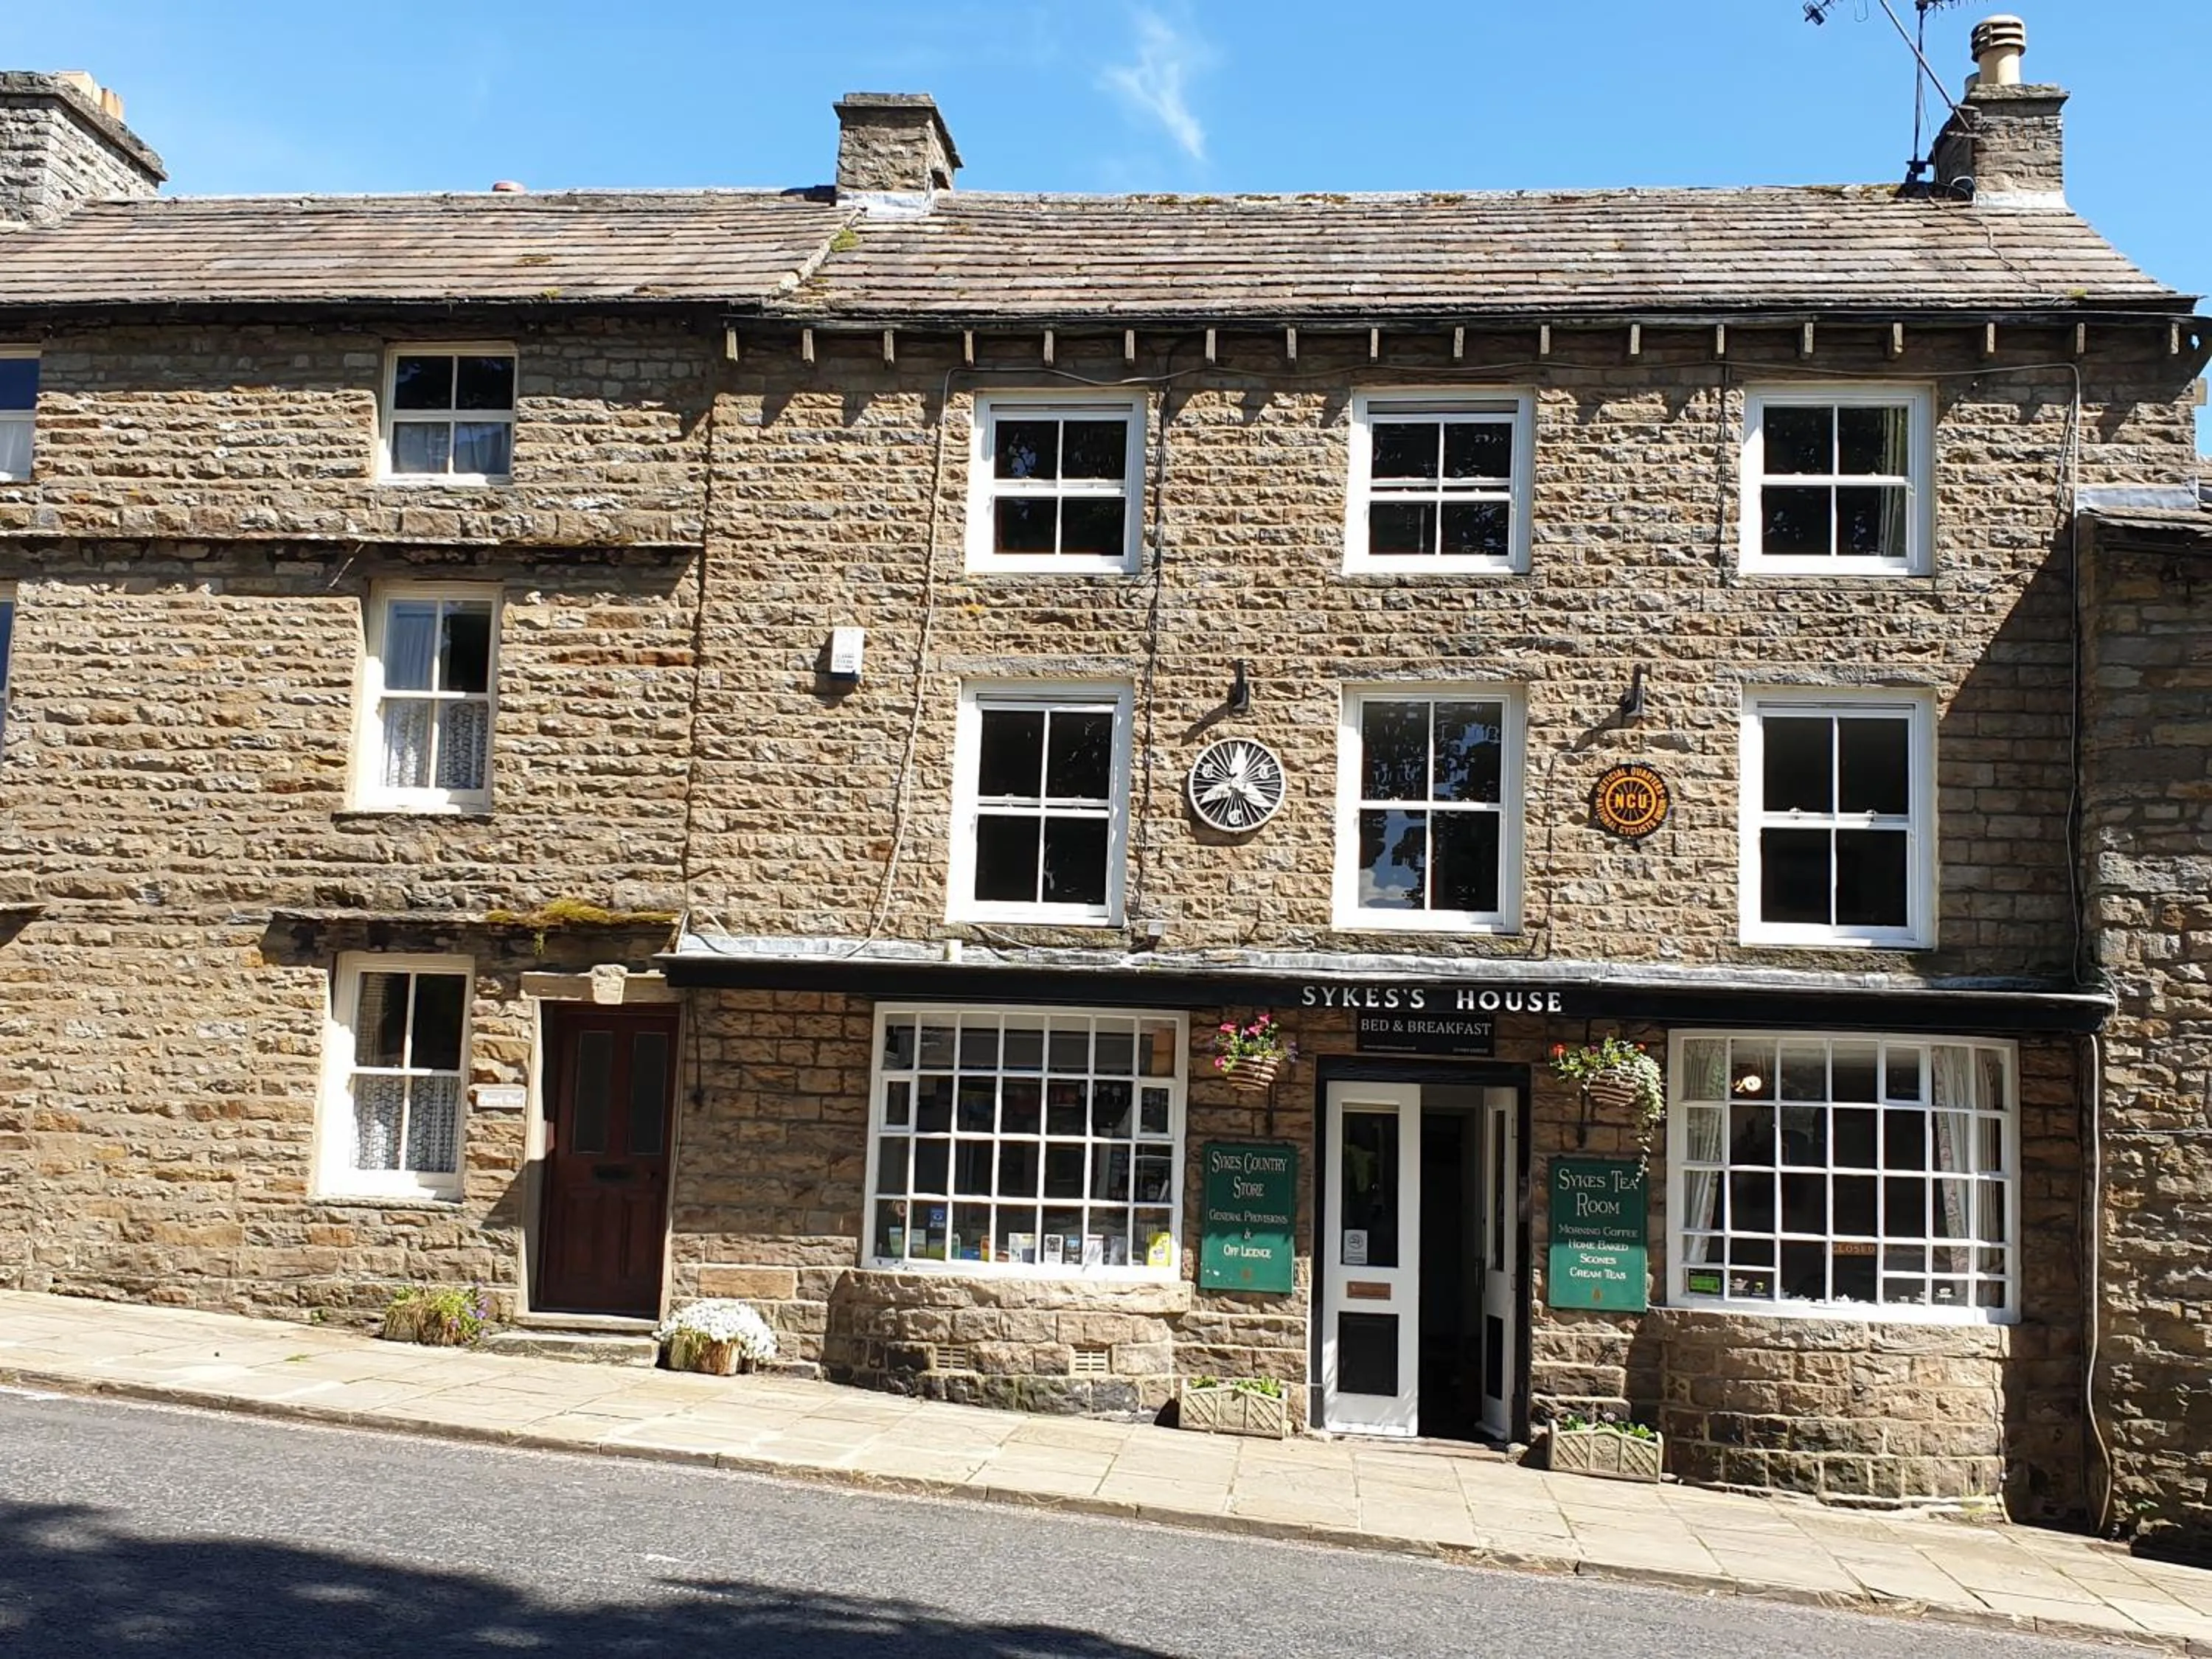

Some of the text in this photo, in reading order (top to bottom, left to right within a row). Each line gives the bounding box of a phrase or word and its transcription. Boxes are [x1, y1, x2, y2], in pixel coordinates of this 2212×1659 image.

[1615, 793, 1647, 809] NCU
[1300, 985, 1563, 1012] SYKES'S HOUSE
[1360, 1018, 1492, 1037] BED & BREAKFAST
[1211, 1151, 1287, 1175] SYKES COUNTRY
[1233, 1176, 1265, 1199] STORE
[1558, 1167, 1638, 1192] SYKES TEA
[1576, 1192, 1621, 1217] ROOM
[1208, 1208, 1288, 1225] GENERAL PROVISIONS
[1243, 1229, 1252, 1240] &
[1558, 1223, 1639, 1238] MORNING COFFEE
[1223, 1244, 1239, 1256] OFF
[1568, 1239, 1629, 1252] HOME BAKED
[1579, 1253, 1617, 1265] SCONES
[1568, 1266, 1627, 1280] CREAM TEAS
